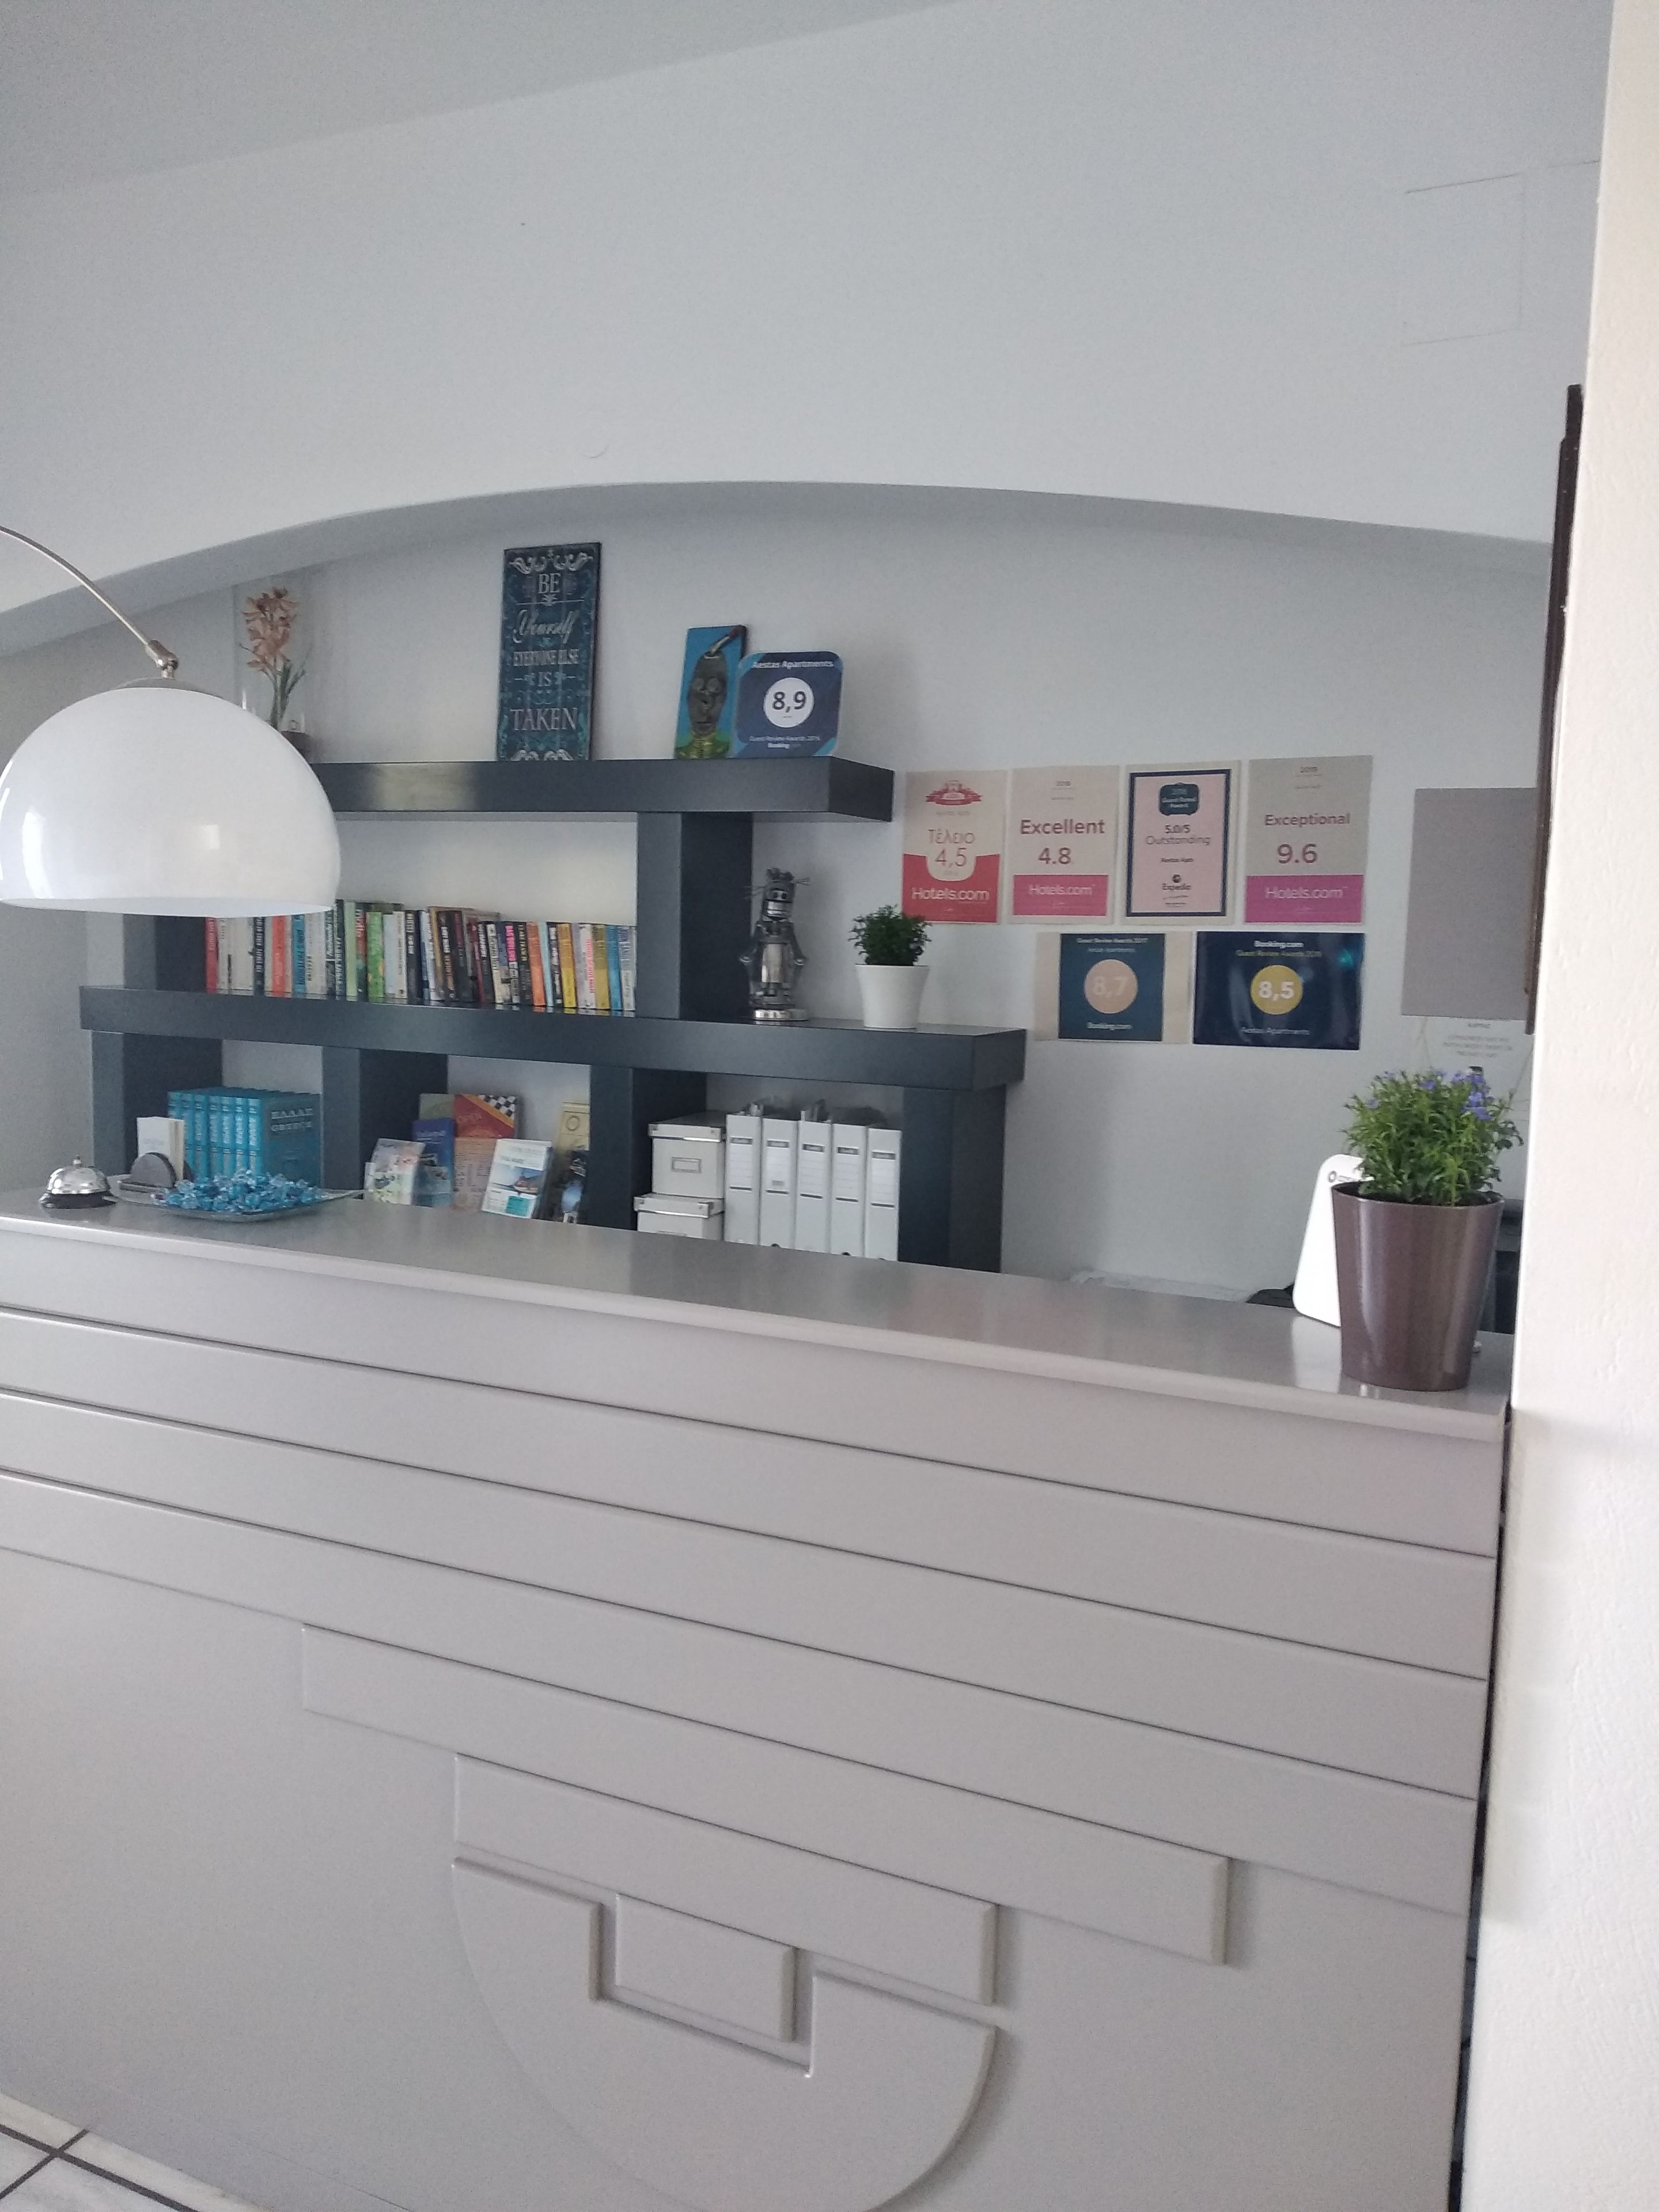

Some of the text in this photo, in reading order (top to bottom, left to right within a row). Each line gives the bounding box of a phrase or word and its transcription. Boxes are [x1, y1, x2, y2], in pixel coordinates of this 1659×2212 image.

[538, 573, 561, 594] BE
[538, 672, 552, 687] IS
[772, 691, 806, 713] 8,9
[510, 708, 578, 732] TAKEN
[1021, 819, 1105, 835] Excellent
[1265, 813, 1350, 827] Exceptional
[1145, 836, 1210, 846] Outstanding
[934, 847, 967, 868] 4,5
[1038, 847, 1071, 865] 4.8
[1278, 843, 1318, 864] 9.6
[911, 887, 990, 900] Hotels.com
[1029, 884, 1093, 895] Hotels.com
[1265, 887, 1344, 899] Hotels.com
[1258, 980, 1295, 1002] 8,5
